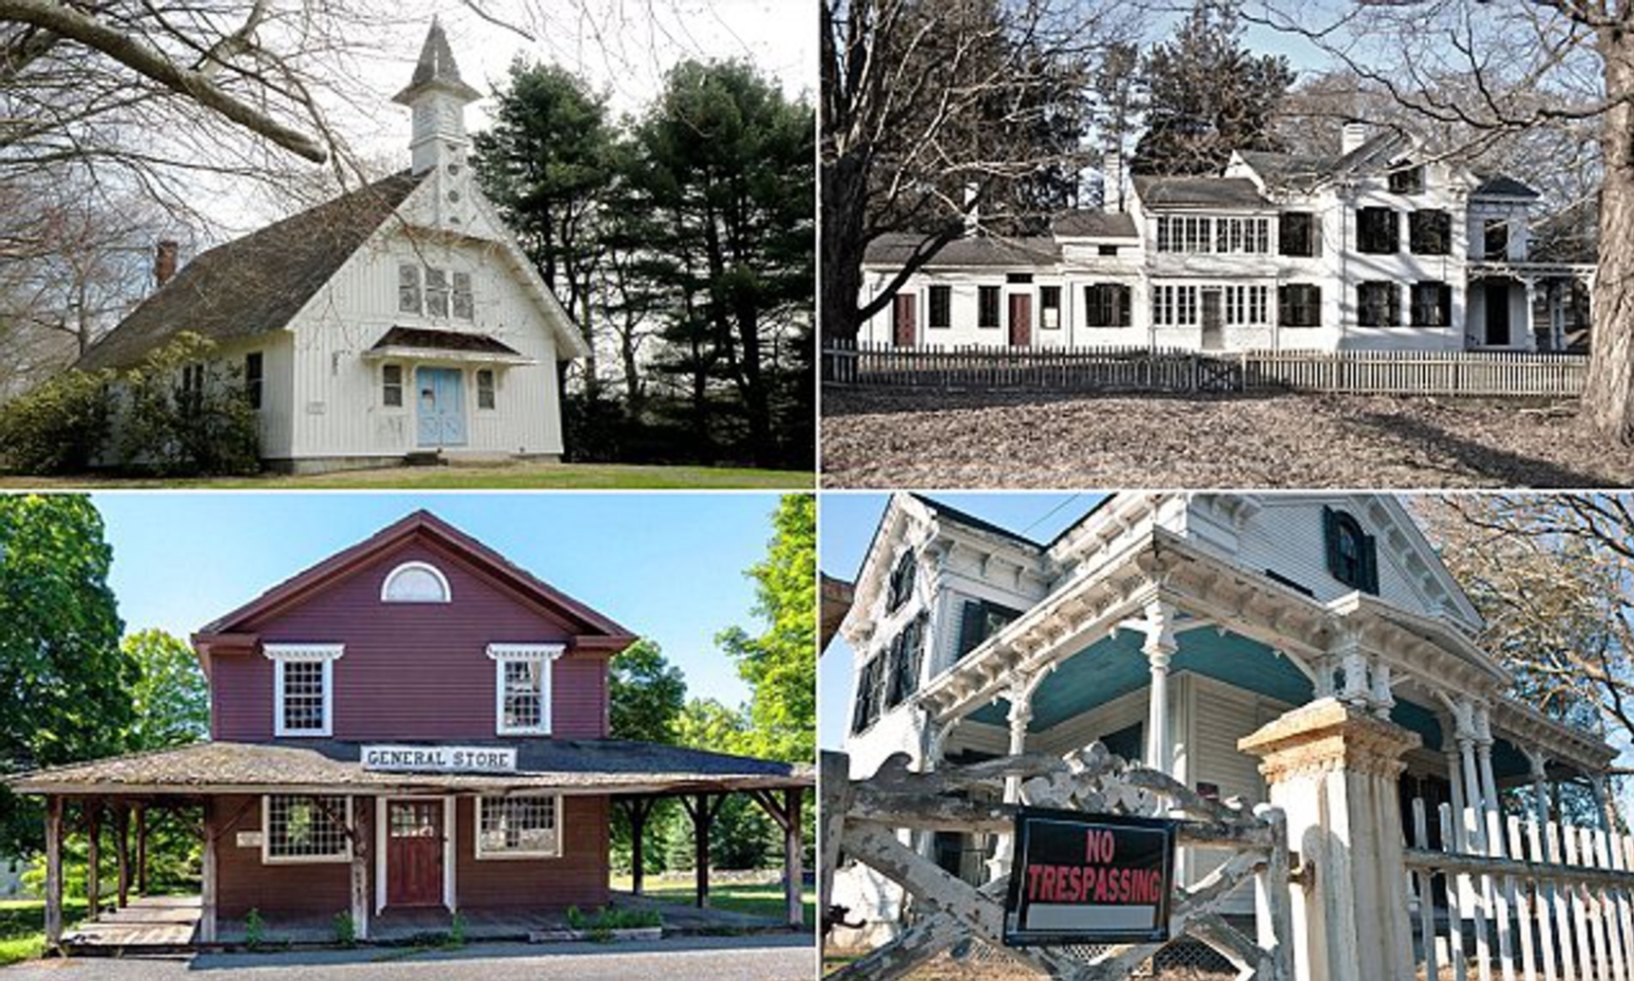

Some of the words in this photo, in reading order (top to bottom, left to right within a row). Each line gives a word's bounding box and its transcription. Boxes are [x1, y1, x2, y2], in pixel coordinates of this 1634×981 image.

[368, 751, 446, 765] GENERAL
[453, 751, 509, 767] STORE
[1085, 829, 1115, 863] NO
[1028, 864, 1161, 903] TRESPASSING
